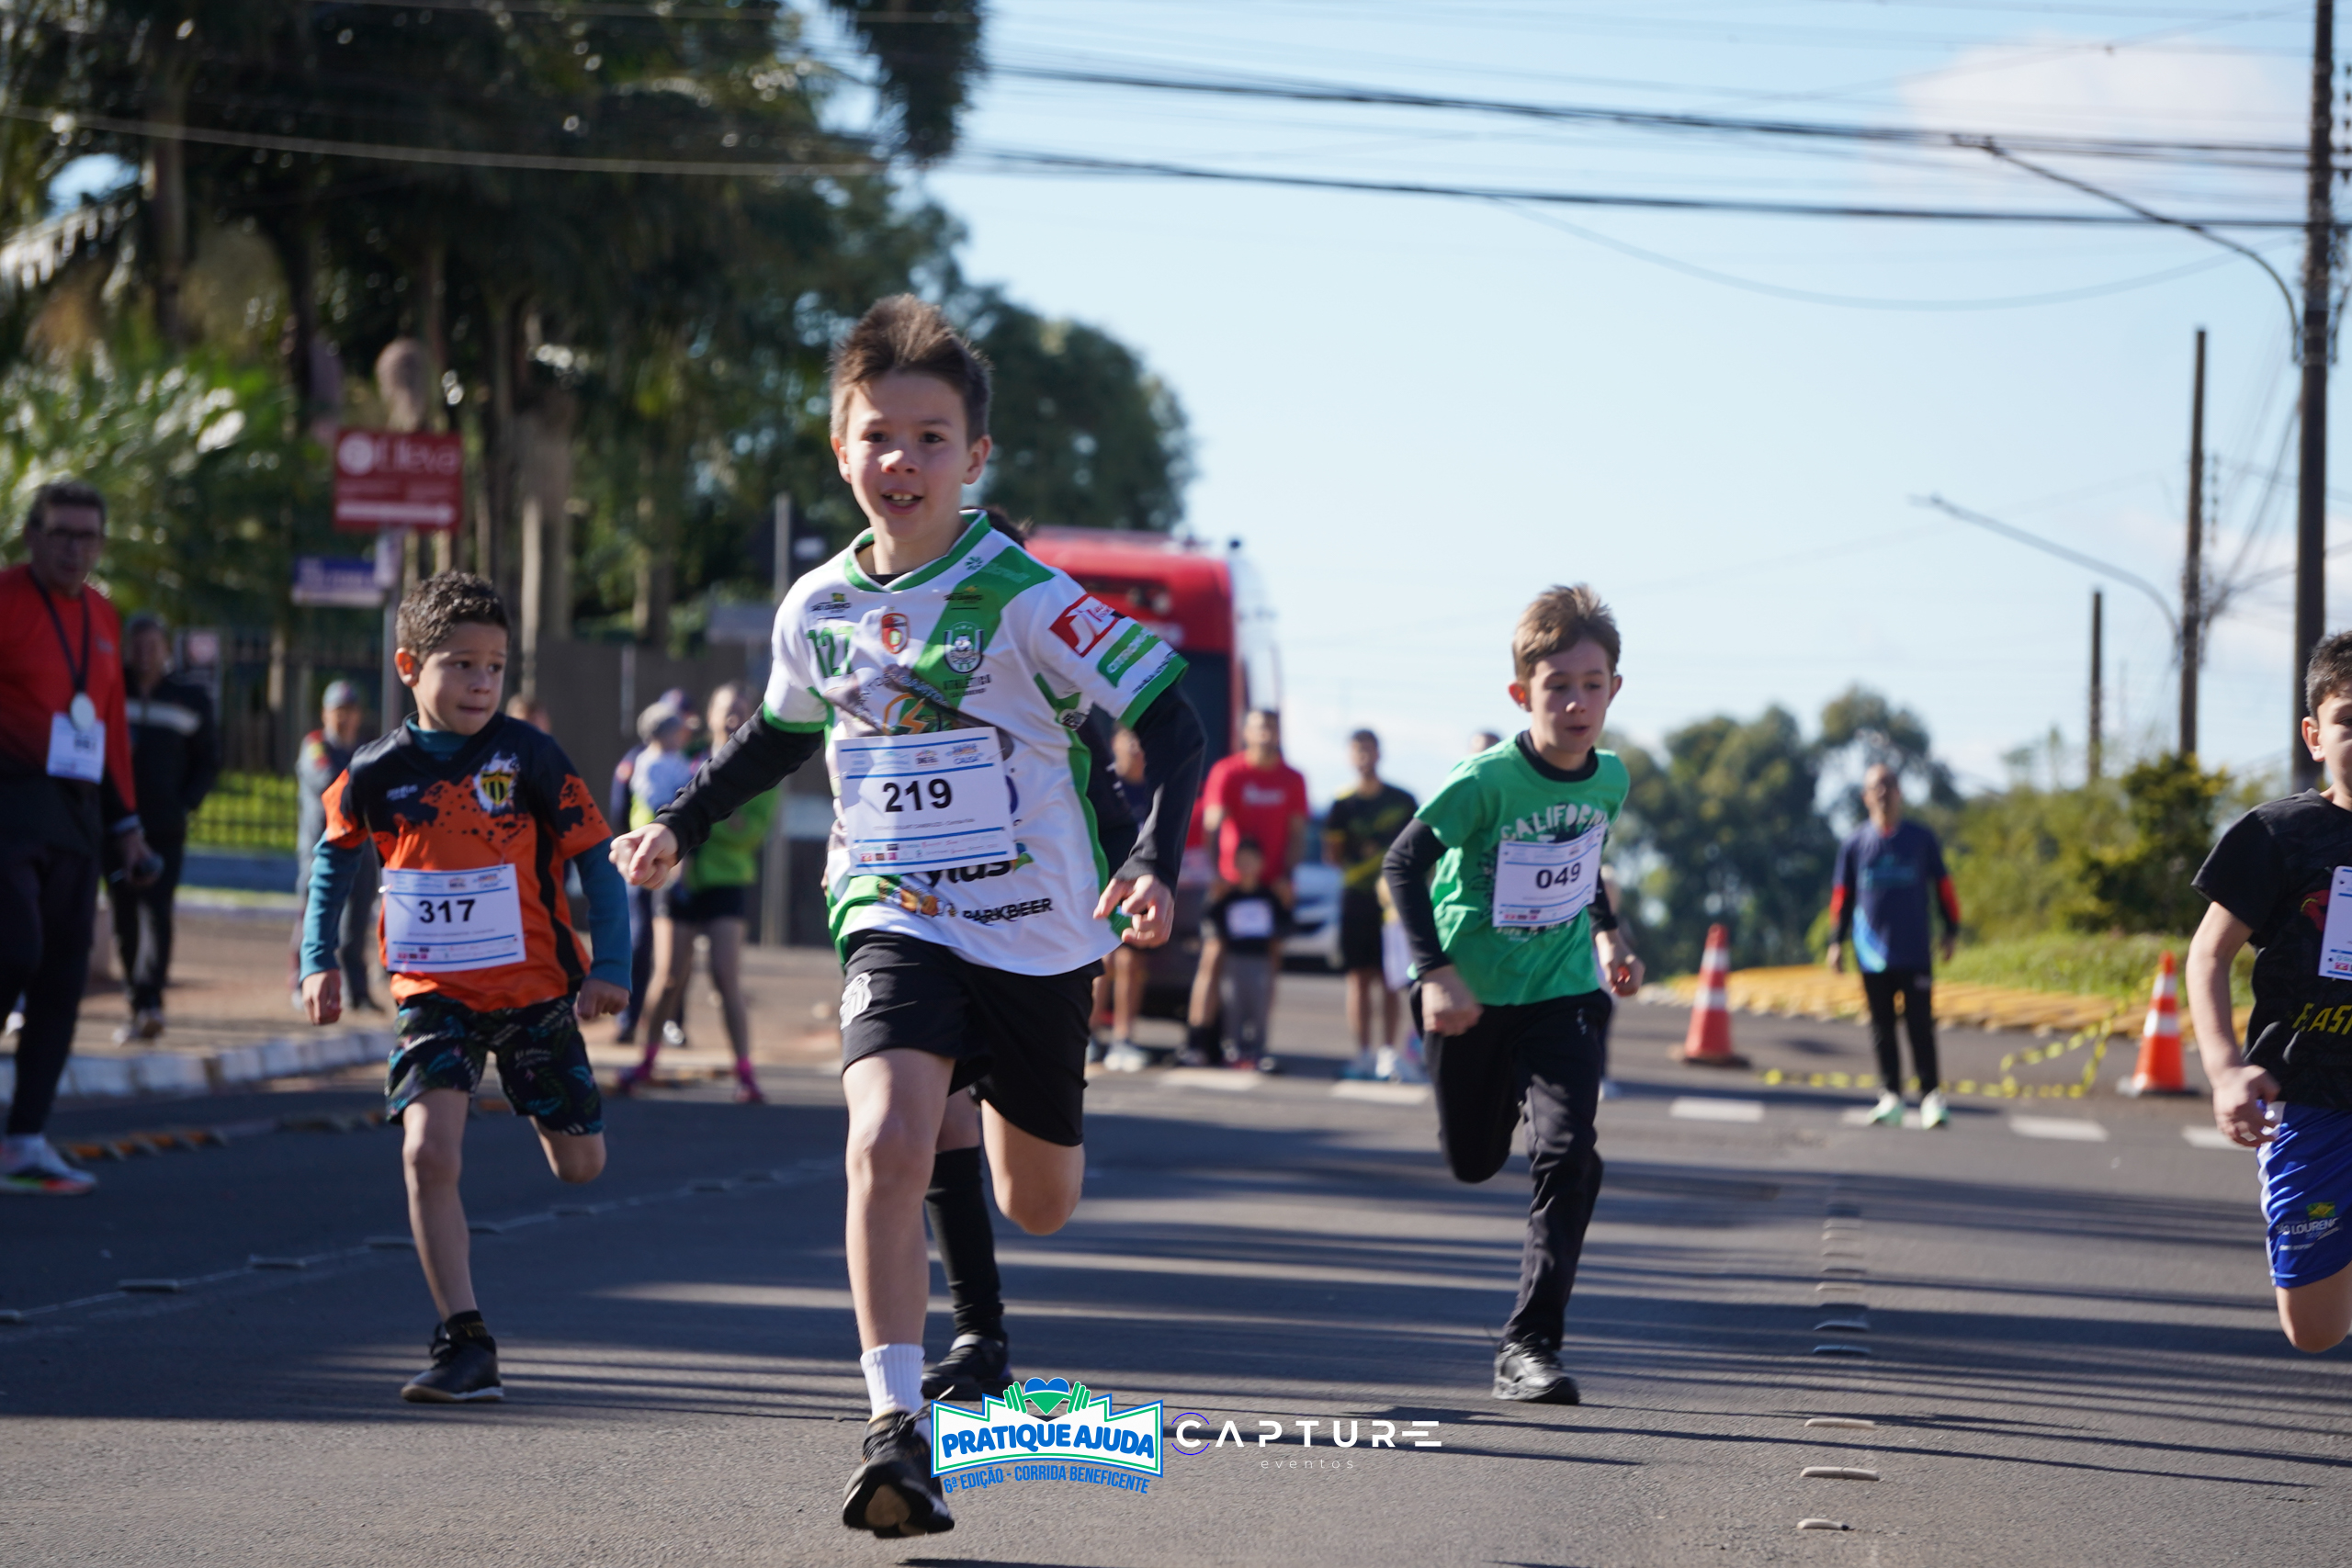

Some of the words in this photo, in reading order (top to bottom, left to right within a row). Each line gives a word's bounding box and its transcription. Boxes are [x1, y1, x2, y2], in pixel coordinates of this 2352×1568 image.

[882, 778, 953, 813] 219
[1535, 862, 1581, 889] 049
[418, 898, 476, 924] 317
[963, 897, 1054, 926] PARKBEER
